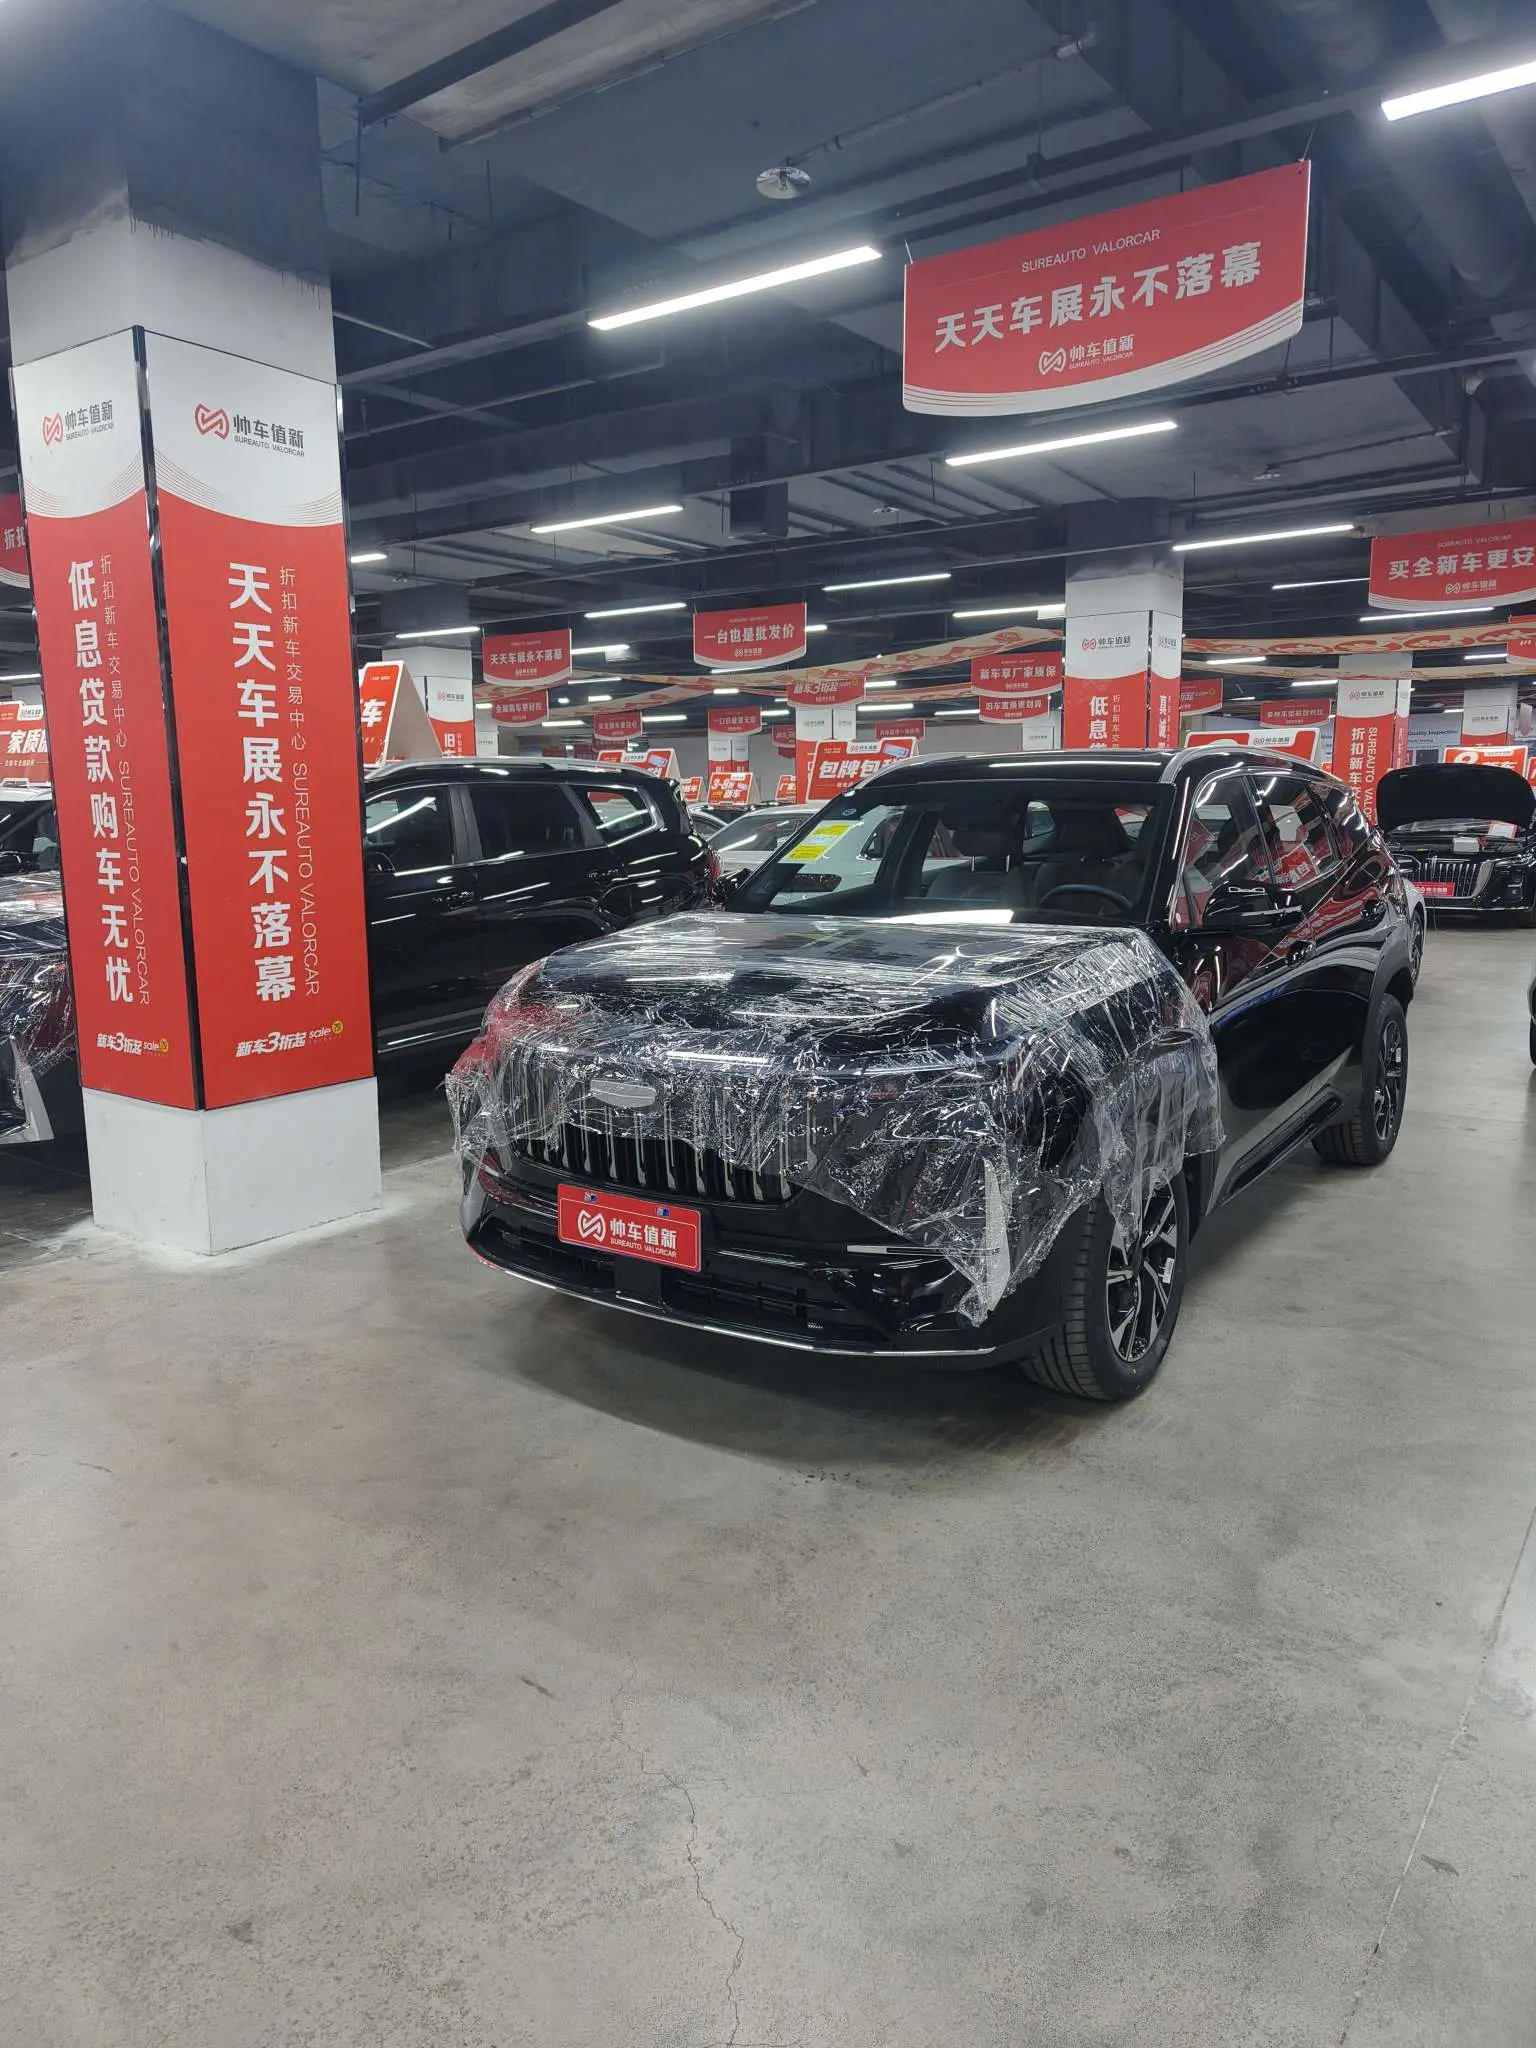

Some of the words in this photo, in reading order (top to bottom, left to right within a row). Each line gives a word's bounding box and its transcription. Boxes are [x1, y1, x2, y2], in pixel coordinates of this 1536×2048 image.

[1021, 246, 1086, 273] SUREAUTO
[1092, 229, 1161, 256] VALORCAR
[934, 240, 1262, 354] 天天车展永不落幕
[1069, 334, 1135, 362] 帅车值新
[64, 400, 113, 432] 帅车值新
[233, 414, 304, 449] 帅车值新
[234, 435, 270, 449] SUREAUTO
[1388, 546, 1536, 580] 买全新车更安
[100, 551, 128, 748] 折扣新车交易中心
[703, 623, 795, 645] 一台也是批发价
[279, 565, 307, 751] 折扣新车交易中心
[68, 560, 134, 1003] 低息贷款购车无忧
[227, 561, 296, 1003] 天天车展永不落幕
[118, 759, 141, 882] SUREAUTO
[292, 762, 314, 880] SUREAUTO
[129, 887, 151, 1006] VALORCAR
[299, 881, 321, 996] VALORCAR
[235, 1031, 307, 1058] 新车3折起
[308, 1026, 332, 1039] sale
[610, 1219, 677, 1249] 帅车值新
[610, 1238, 642, 1250] SUREAUTO
[644, 1245, 677, 1258] VALORCAR
